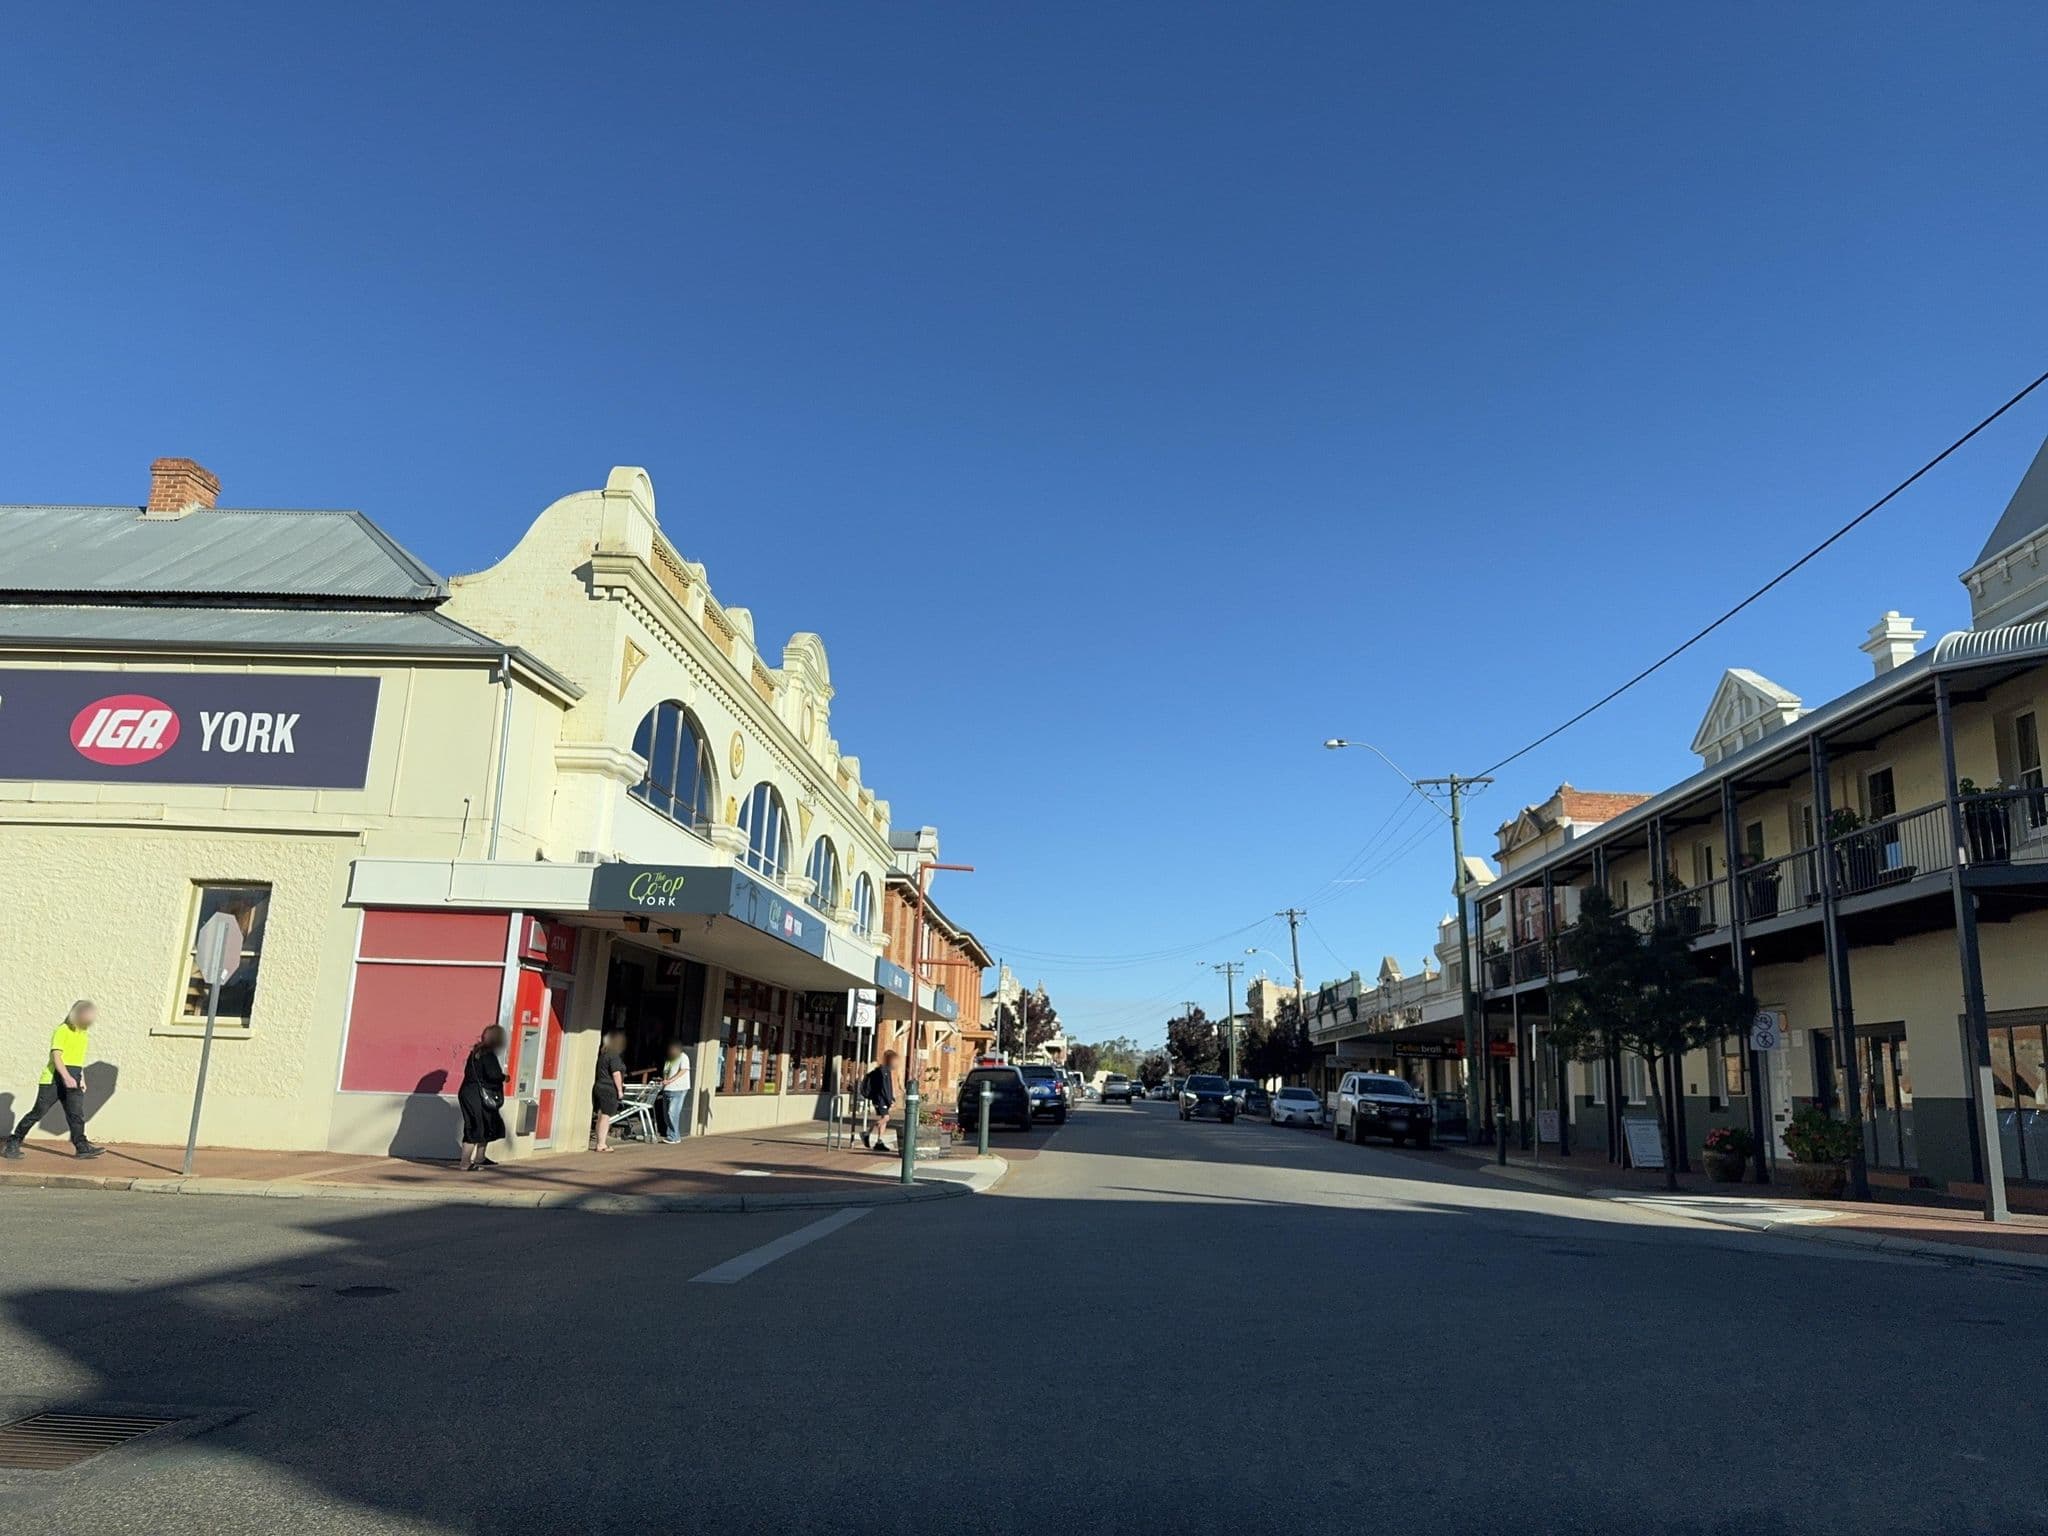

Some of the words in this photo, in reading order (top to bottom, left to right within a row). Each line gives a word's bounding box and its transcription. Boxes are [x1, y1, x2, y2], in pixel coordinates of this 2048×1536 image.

[78, 708, 174, 750] IGA
[199, 710, 300, 754] YORK
[629, 872, 684, 900] Co-op
[637, 896, 676, 907] YORK
[551, 936, 567, 952] ATM
